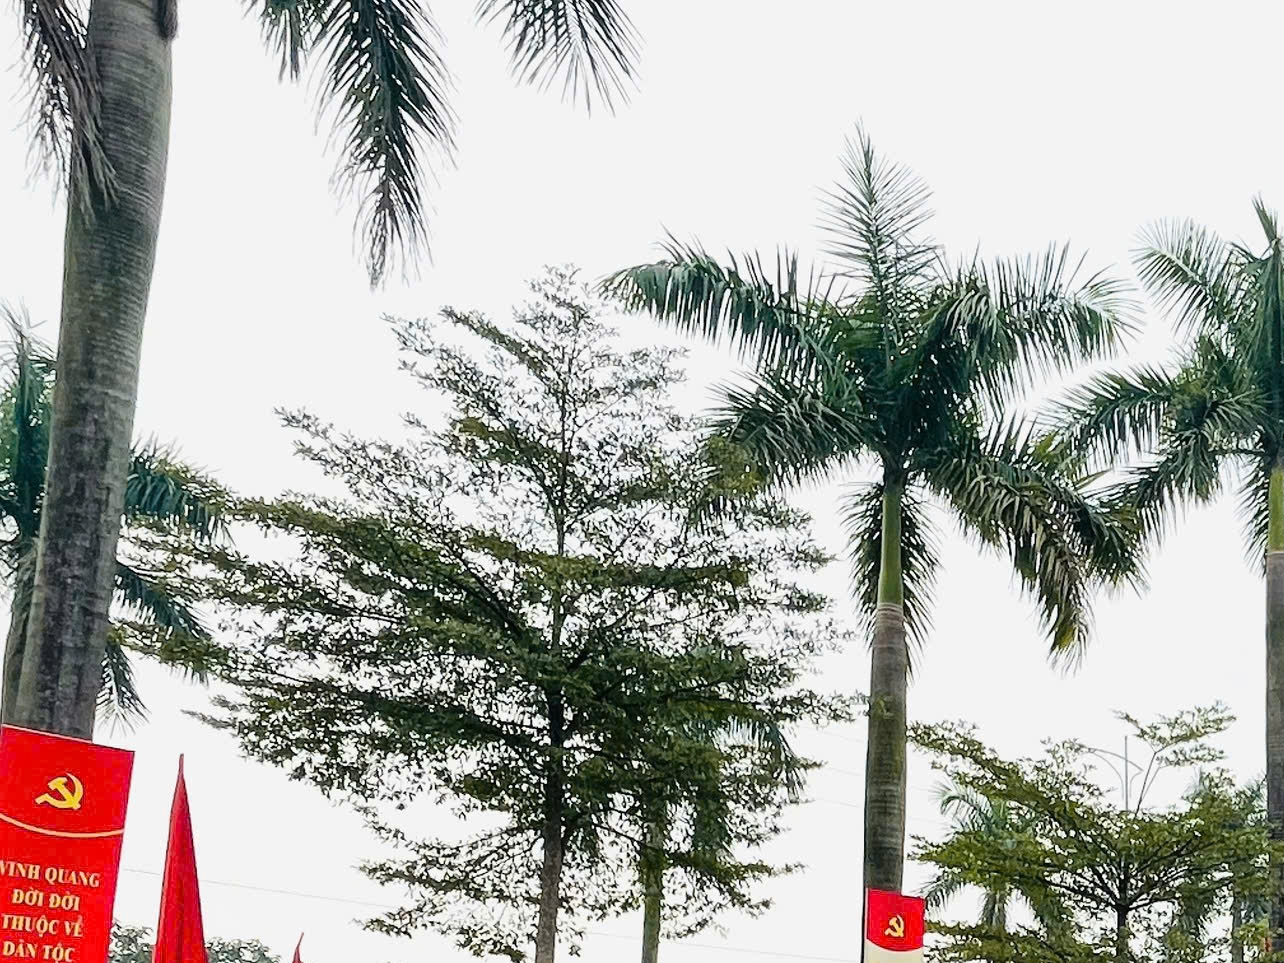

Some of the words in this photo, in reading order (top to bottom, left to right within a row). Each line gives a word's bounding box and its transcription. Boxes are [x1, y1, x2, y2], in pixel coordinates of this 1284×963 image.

[0, 859, 41, 880] VINH
[44, 867, 100, 888] QUANG
[12, 886, 44, 907] ĐỜI
[48, 890, 80, 911] ĐỜI
[2, 913, 60, 938] THUỘC
[64, 914, 84, 937] VỀ
[3, 939, 38, 959] DÂN
